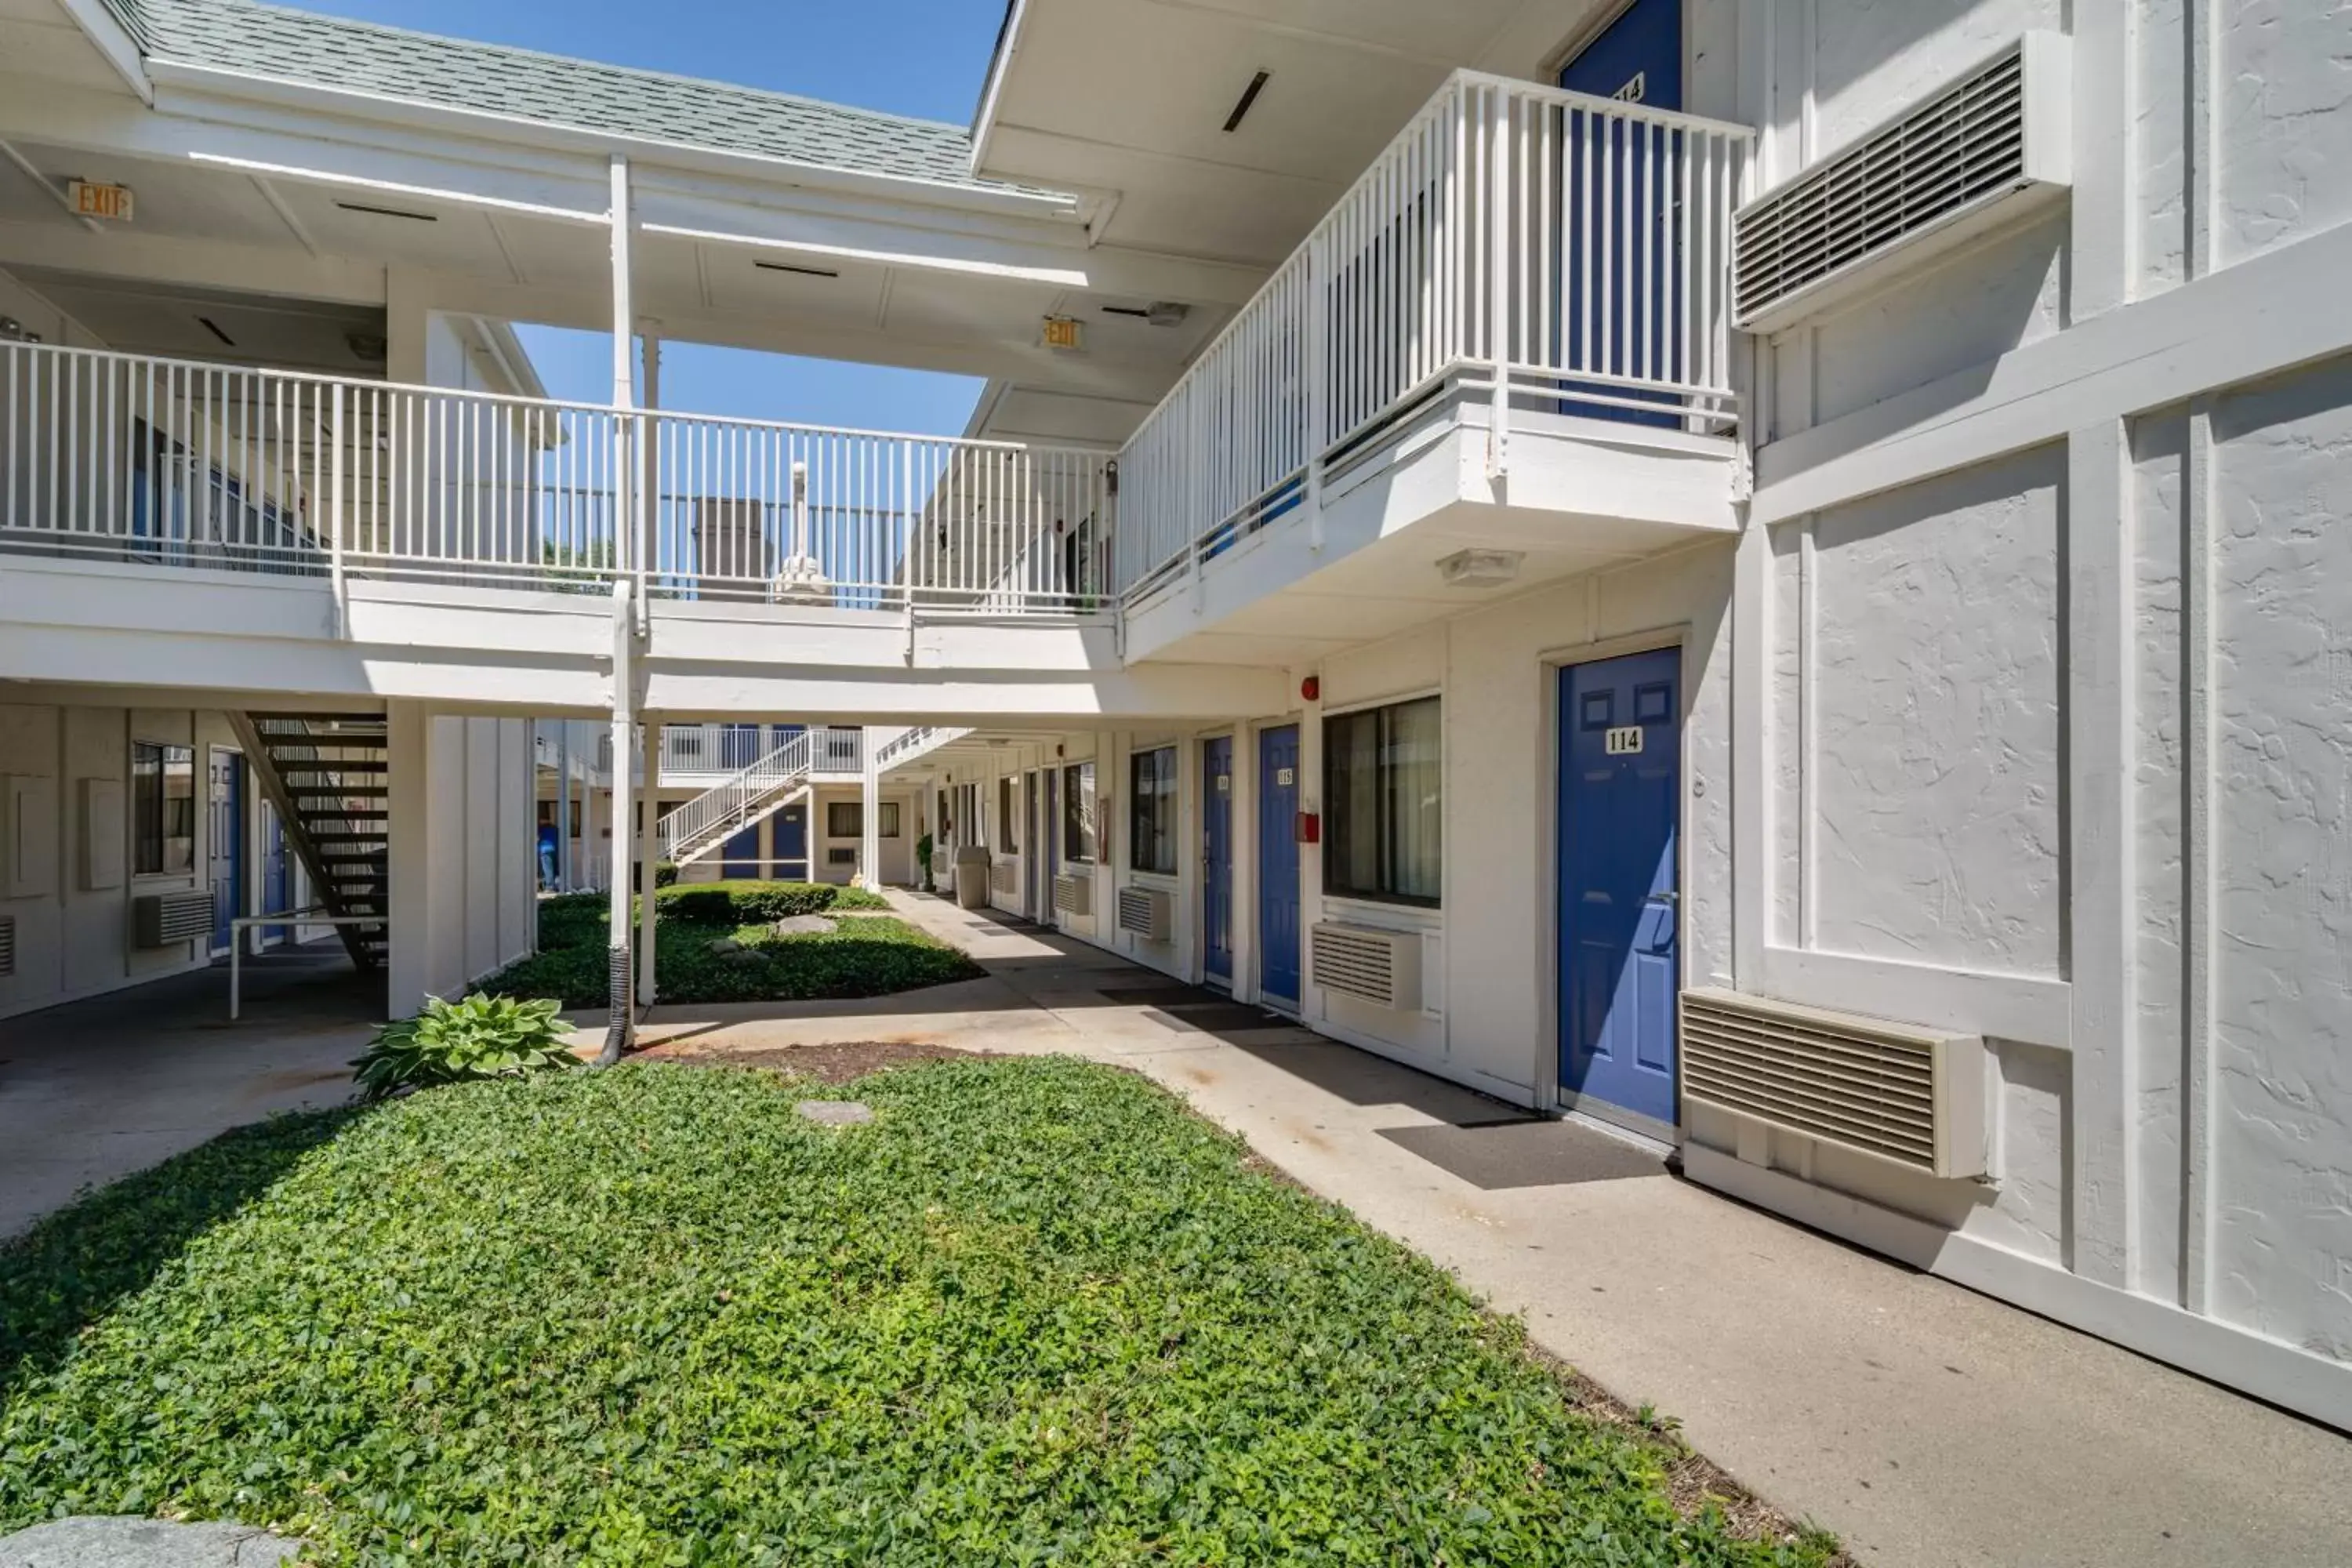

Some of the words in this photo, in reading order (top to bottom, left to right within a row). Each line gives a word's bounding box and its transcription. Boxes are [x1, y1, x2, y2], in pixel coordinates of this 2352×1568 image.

[1614, 78, 1640, 101] 14
[79, 184, 122, 216] EXIT
[1049, 321, 1076, 346] EXIT
[1610, 730, 1639, 750] 114
